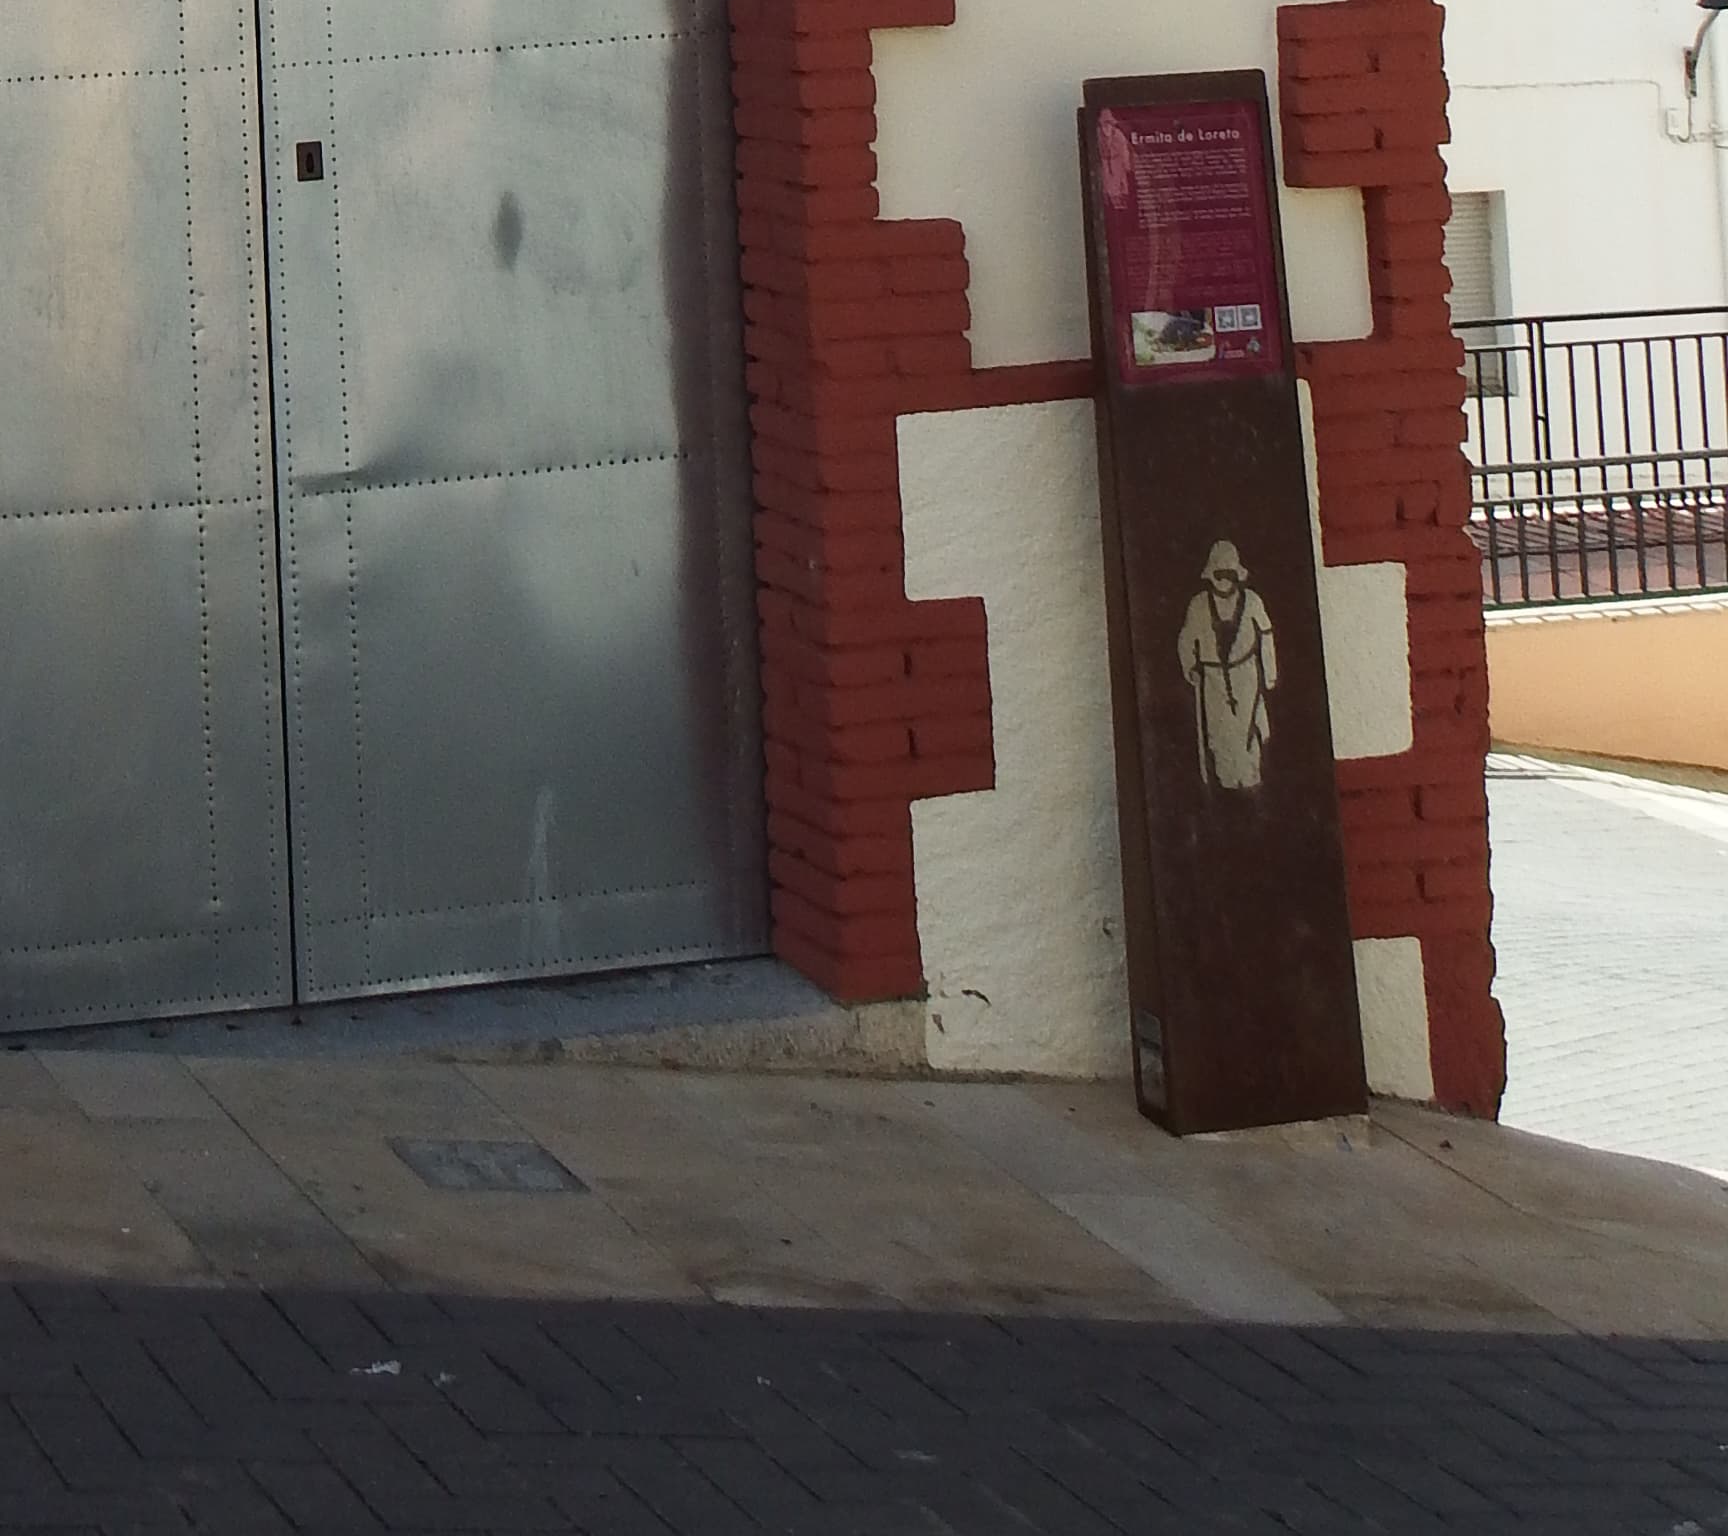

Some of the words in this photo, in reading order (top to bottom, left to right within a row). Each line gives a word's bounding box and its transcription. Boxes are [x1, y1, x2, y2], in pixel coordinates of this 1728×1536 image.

[1130, 131, 1172, 144] Ermita
[1177, 129, 1193, 142] de
[1198, 128, 1240, 141] Loreto
